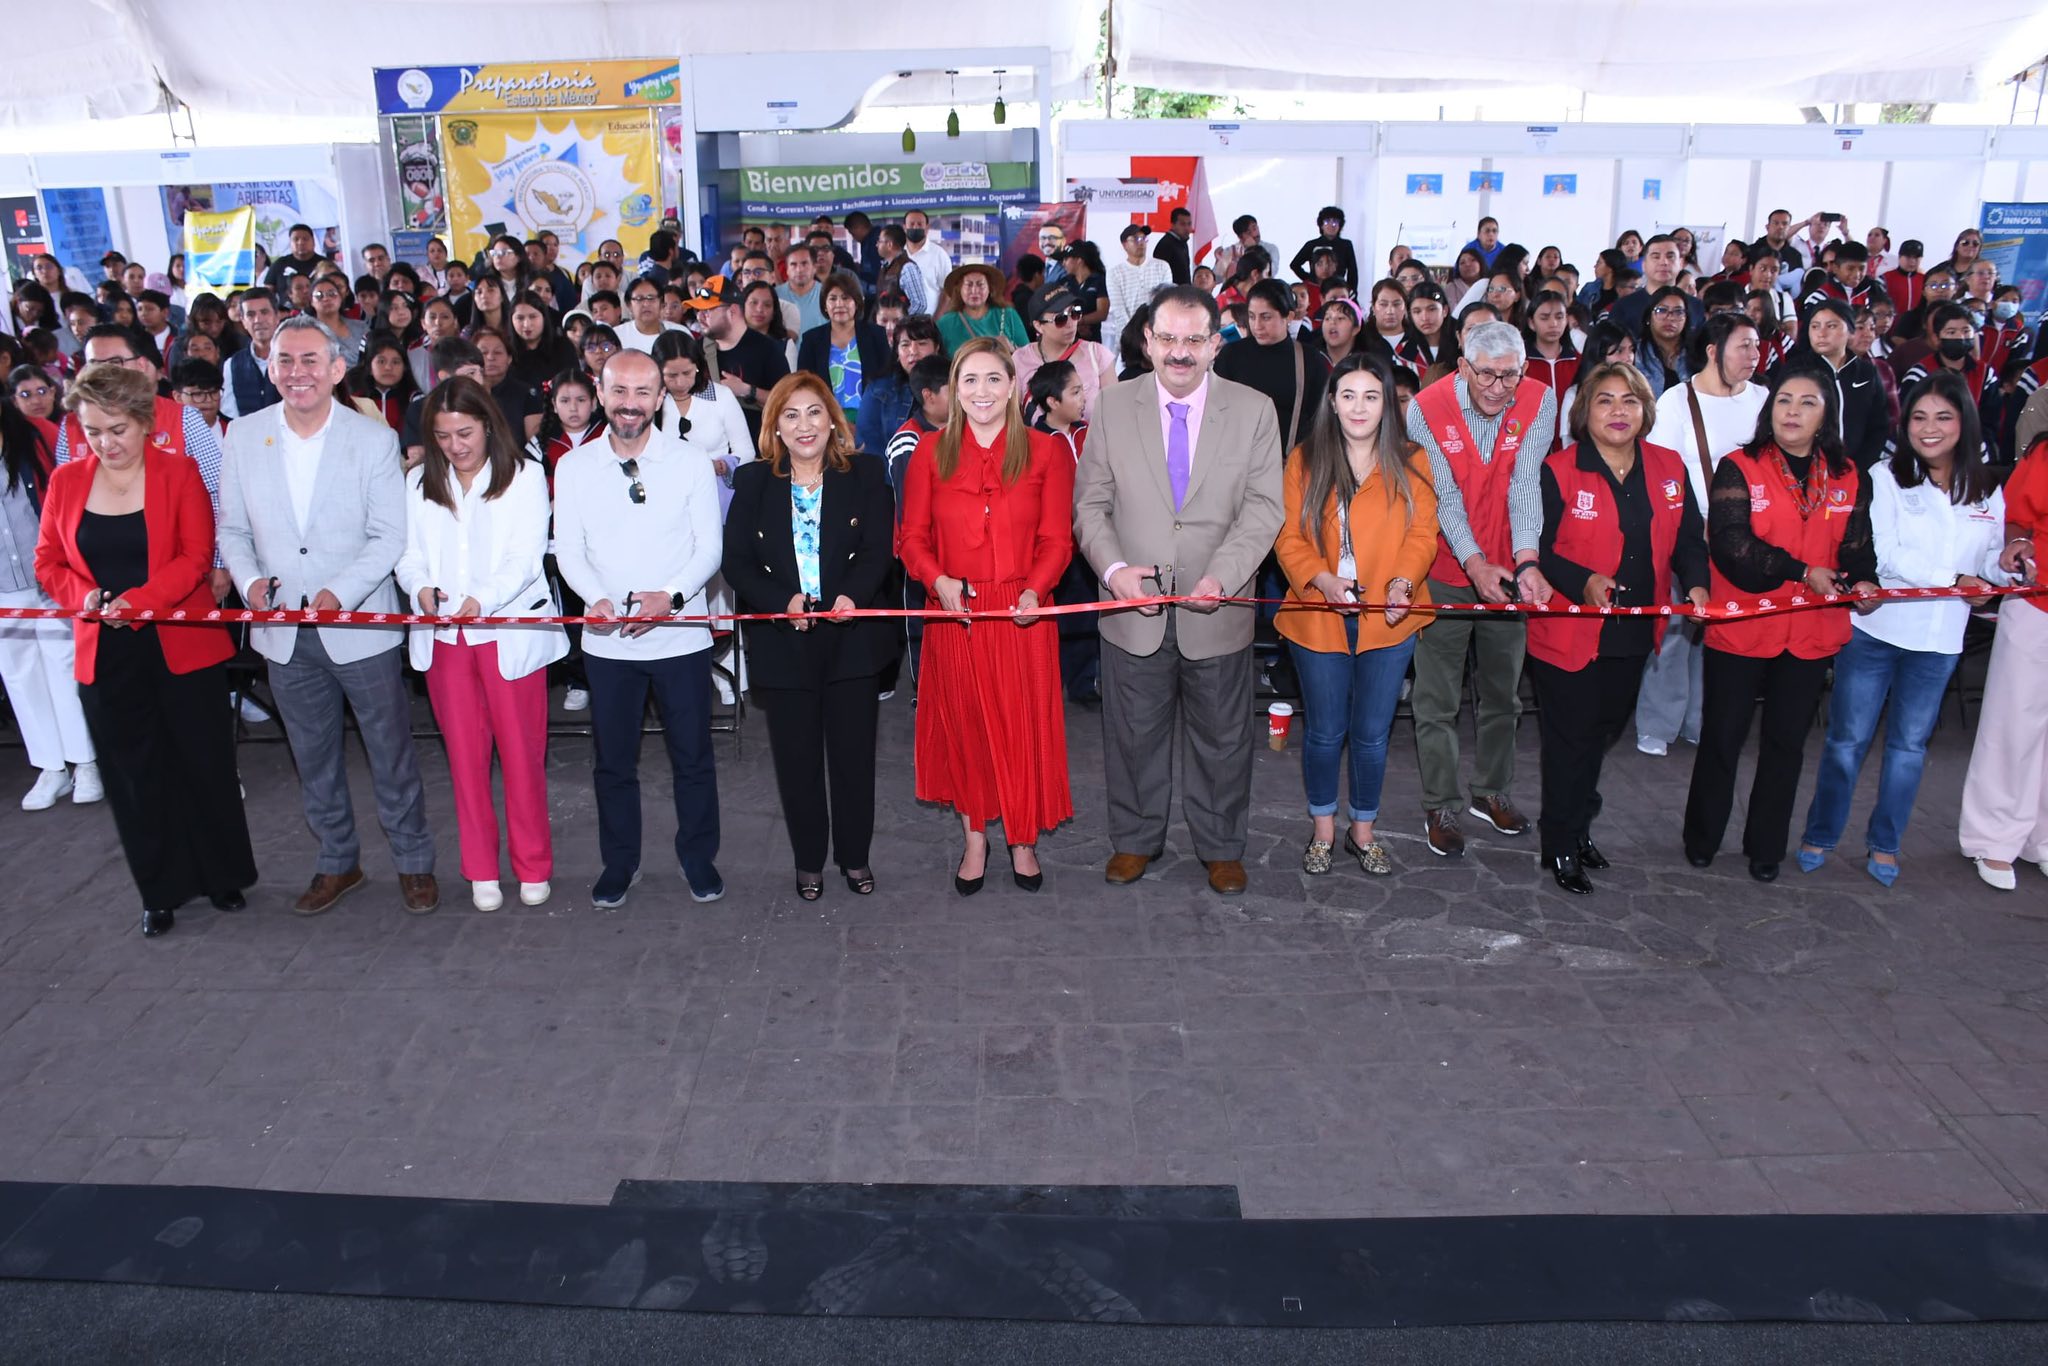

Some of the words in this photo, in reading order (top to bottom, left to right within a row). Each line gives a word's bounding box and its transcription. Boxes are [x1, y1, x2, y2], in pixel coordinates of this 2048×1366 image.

[459, 68, 596, 98] Preparatoria
[544, 93, 556, 106] de
[747, 163, 901, 193] Bienvenidos
[237, 190, 293, 204] ABIERTAS
[1099, 189, 1155, 199] UNIVERSIDAD
[747, 204, 768, 213] Cendi
[842, 199, 883, 210] Bachillerato
[891, 196, 937, 206] Licenciaturas
[988, 192, 1026, 203] Doctorado
[2002, 217, 2042, 225] INNOVA
